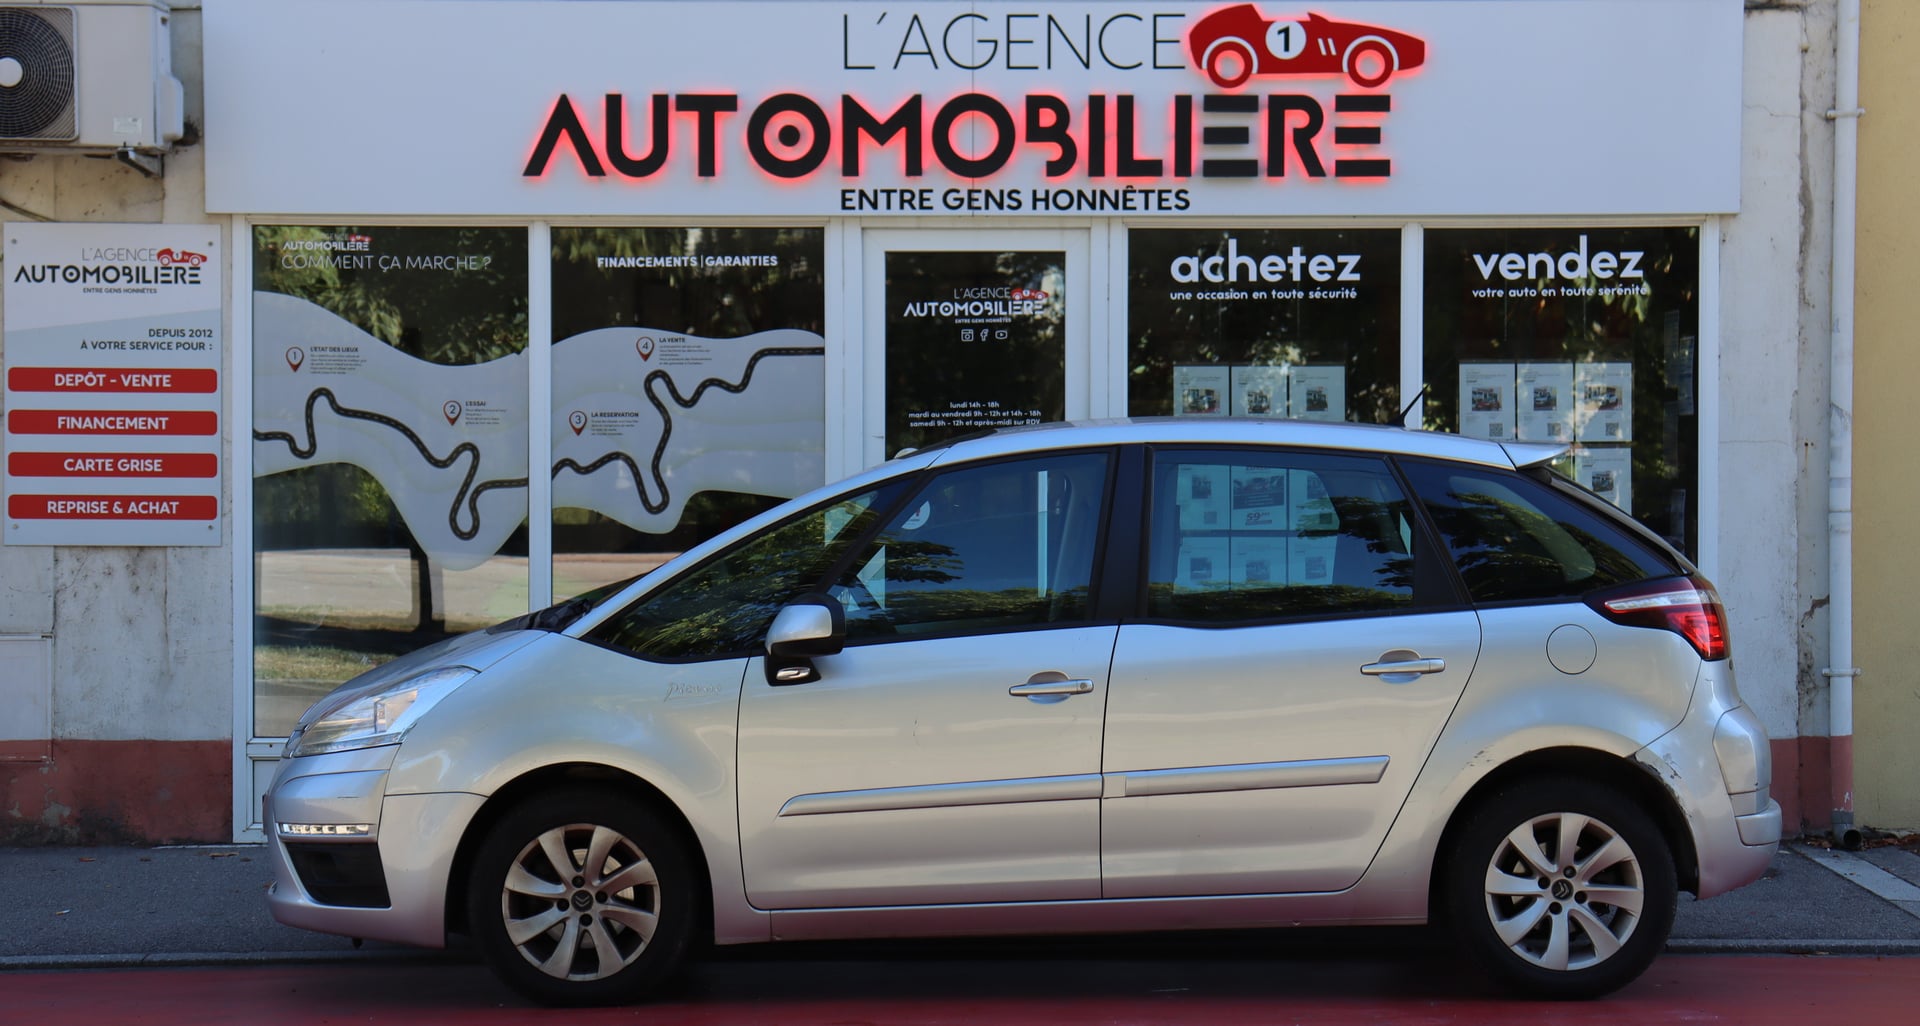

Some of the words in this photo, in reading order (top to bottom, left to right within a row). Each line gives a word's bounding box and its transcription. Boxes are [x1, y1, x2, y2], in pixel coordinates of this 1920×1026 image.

[844, 12, 1186, 70] L'AGENCE
[1277, 25, 1290, 52] 1
[841, 189, 934, 210] ENTRE
[942, 189, 1022, 210] GENS
[1042, 185, 1190, 211] HONNÊTES
[82, 248, 157, 261] L'AGENCE
[1170, 238, 1361, 283] achetez
[1472, 234, 1645, 280] vendez
[282, 254, 374, 269] COMMENT
[378, 255, 401, 272] ÇA
[405, 255, 478, 270] MARCHE
[597, 256, 698, 268] FINANCEMENTS
[705, 255, 778, 267] GARANTIES
[954, 288, 1011, 300] L'AGENCE
[1170, 292, 1192, 300] une
[1196, 288, 1248, 300] occasion
[1252, 291, 1268, 300] en
[1271, 289, 1304, 299] toute
[1308, 286, 1358, 299] sécurité
[1472, 288, 1504, 298] votre
[1508, 287, 1537, 298] auto
[1541, 288, 1556, 297] en
[1560, 286, 1594, 296] toute
[148, 329, 186, 337] DEPUIS
[188, 329, 213, 338] 2012
[80, 340, 88, 350] À
[91, 342, 126, 350] VOTRE
[130, 342, 172, 350] SERVICE
[176, 342, 205, 350] POUR
[54, 372, 106, 386] DEPÔT
[120, 375, 171, 387] VENTE
[450, 405, 456, 414] 2
[58, 417, 168, 430] FINANCEMENT
[575, 415, 581, 424] 3
[974, 419, 1012, 427] après-midi
[64, 459, 114, 471] CARTE
[117, 459, 163, 472] GRISE
[47, 501, 108, 513] REPRISE
[113, 502, 123, 514] &
[128, 502, 179, 514] ACHAT
